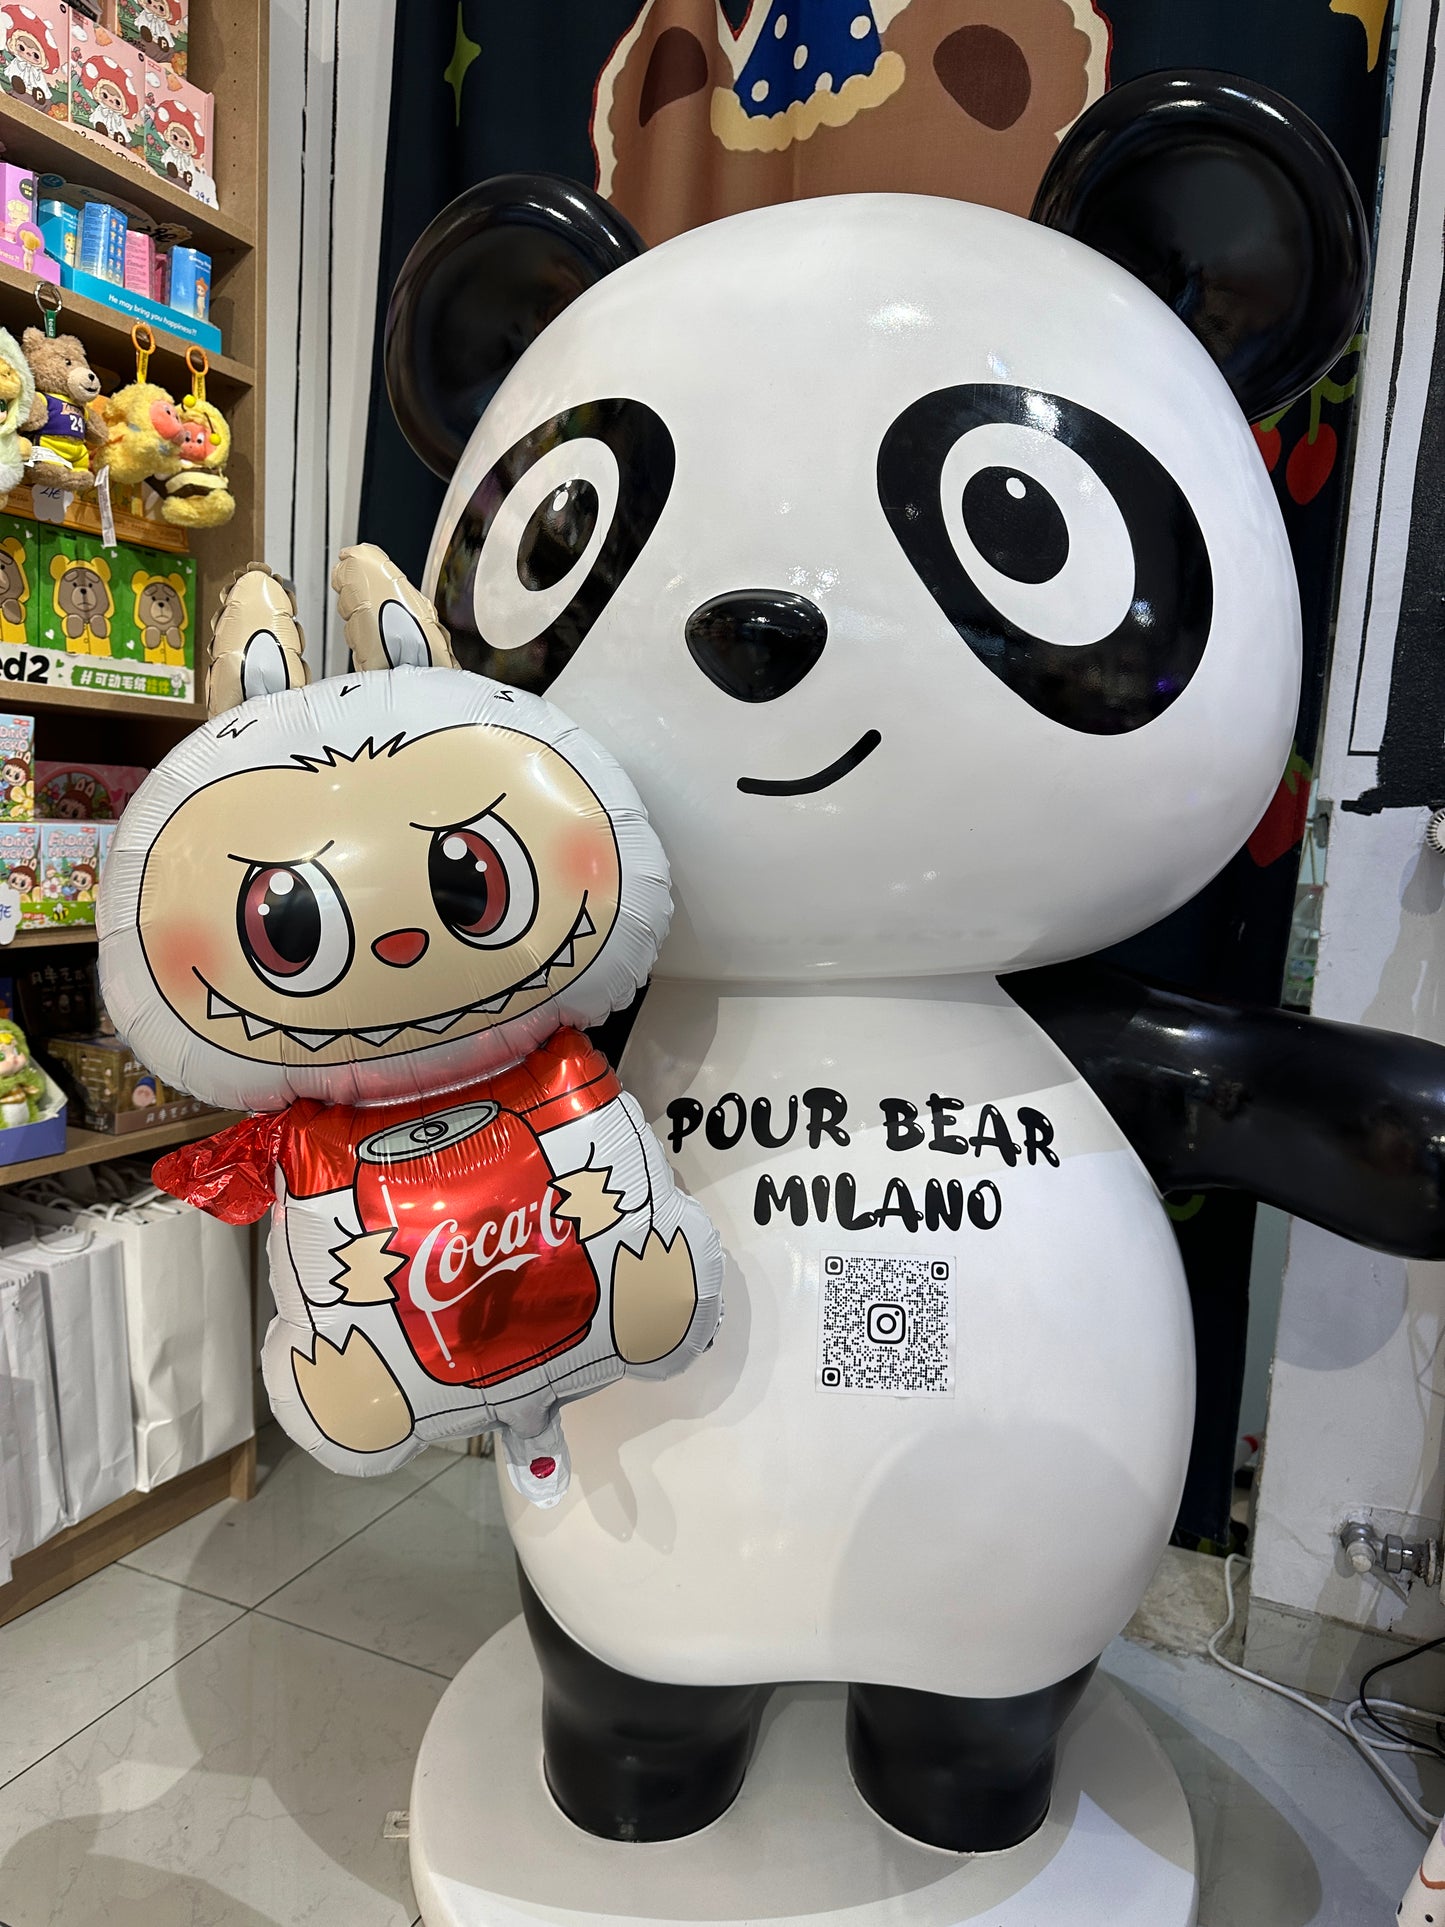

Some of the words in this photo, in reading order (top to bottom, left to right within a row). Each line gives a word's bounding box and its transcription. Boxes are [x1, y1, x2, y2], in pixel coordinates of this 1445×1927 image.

[108, 294, 118, 304] He
[119, 300, 134, 311] may
[134, 304, 151, 318] bring
[150, 312, 162, 322] you
[69, 414, 84, 433] 24
[0, 651, 50, 684] d2
[666, 1087, 851, 1154] POUR
[879, 1092, 1061, 1168] BEAR
[753, 1171, 1003, 1233] MILANO
